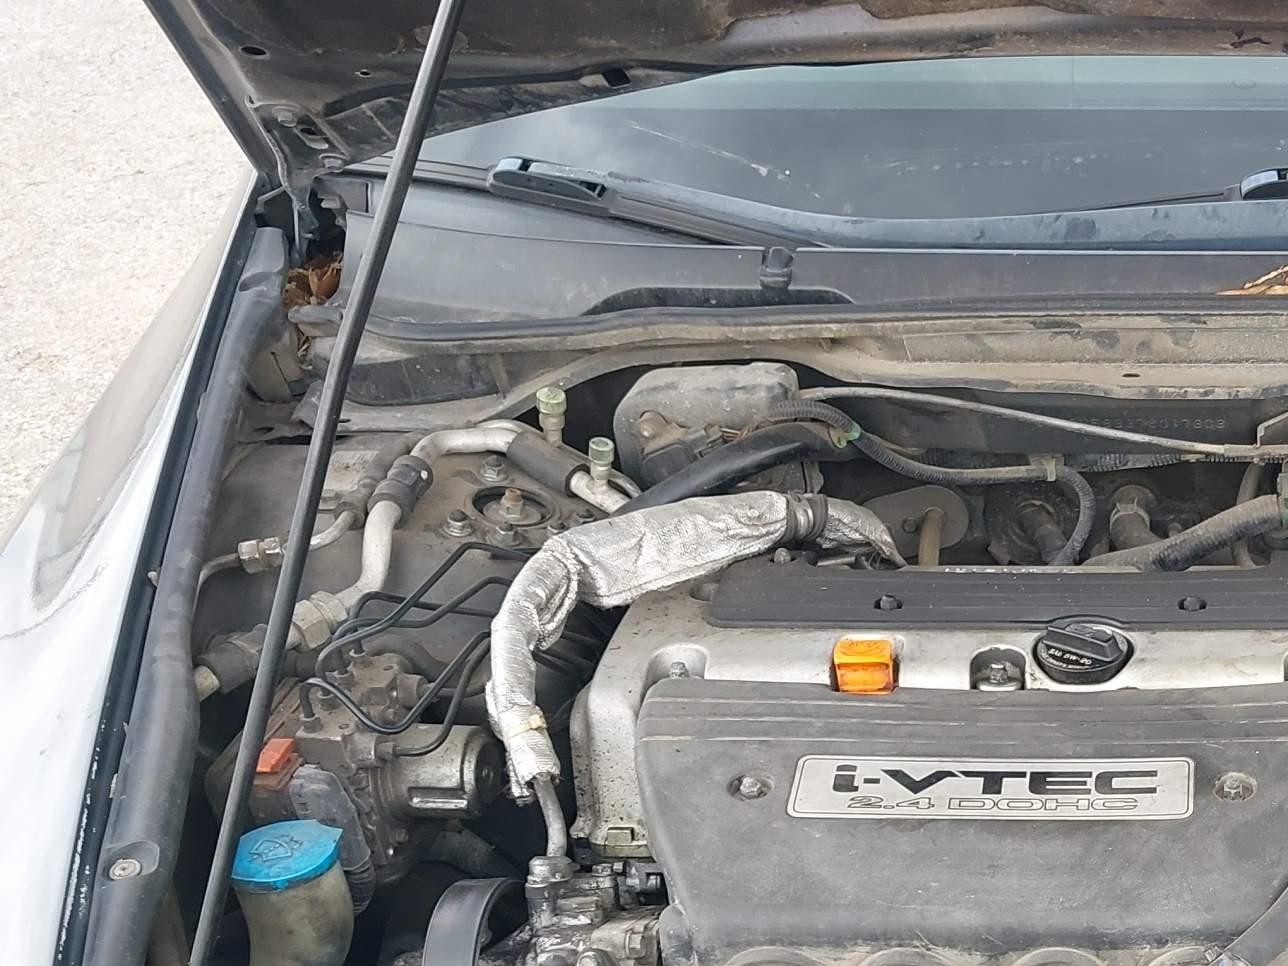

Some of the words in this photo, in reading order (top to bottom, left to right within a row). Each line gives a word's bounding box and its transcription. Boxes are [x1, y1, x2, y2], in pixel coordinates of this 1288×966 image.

[832, 764, 1159, 795] i-VTEC
[847, 796, 935, 810] 2.4
[947, 797, 1138, 811] DOHC
